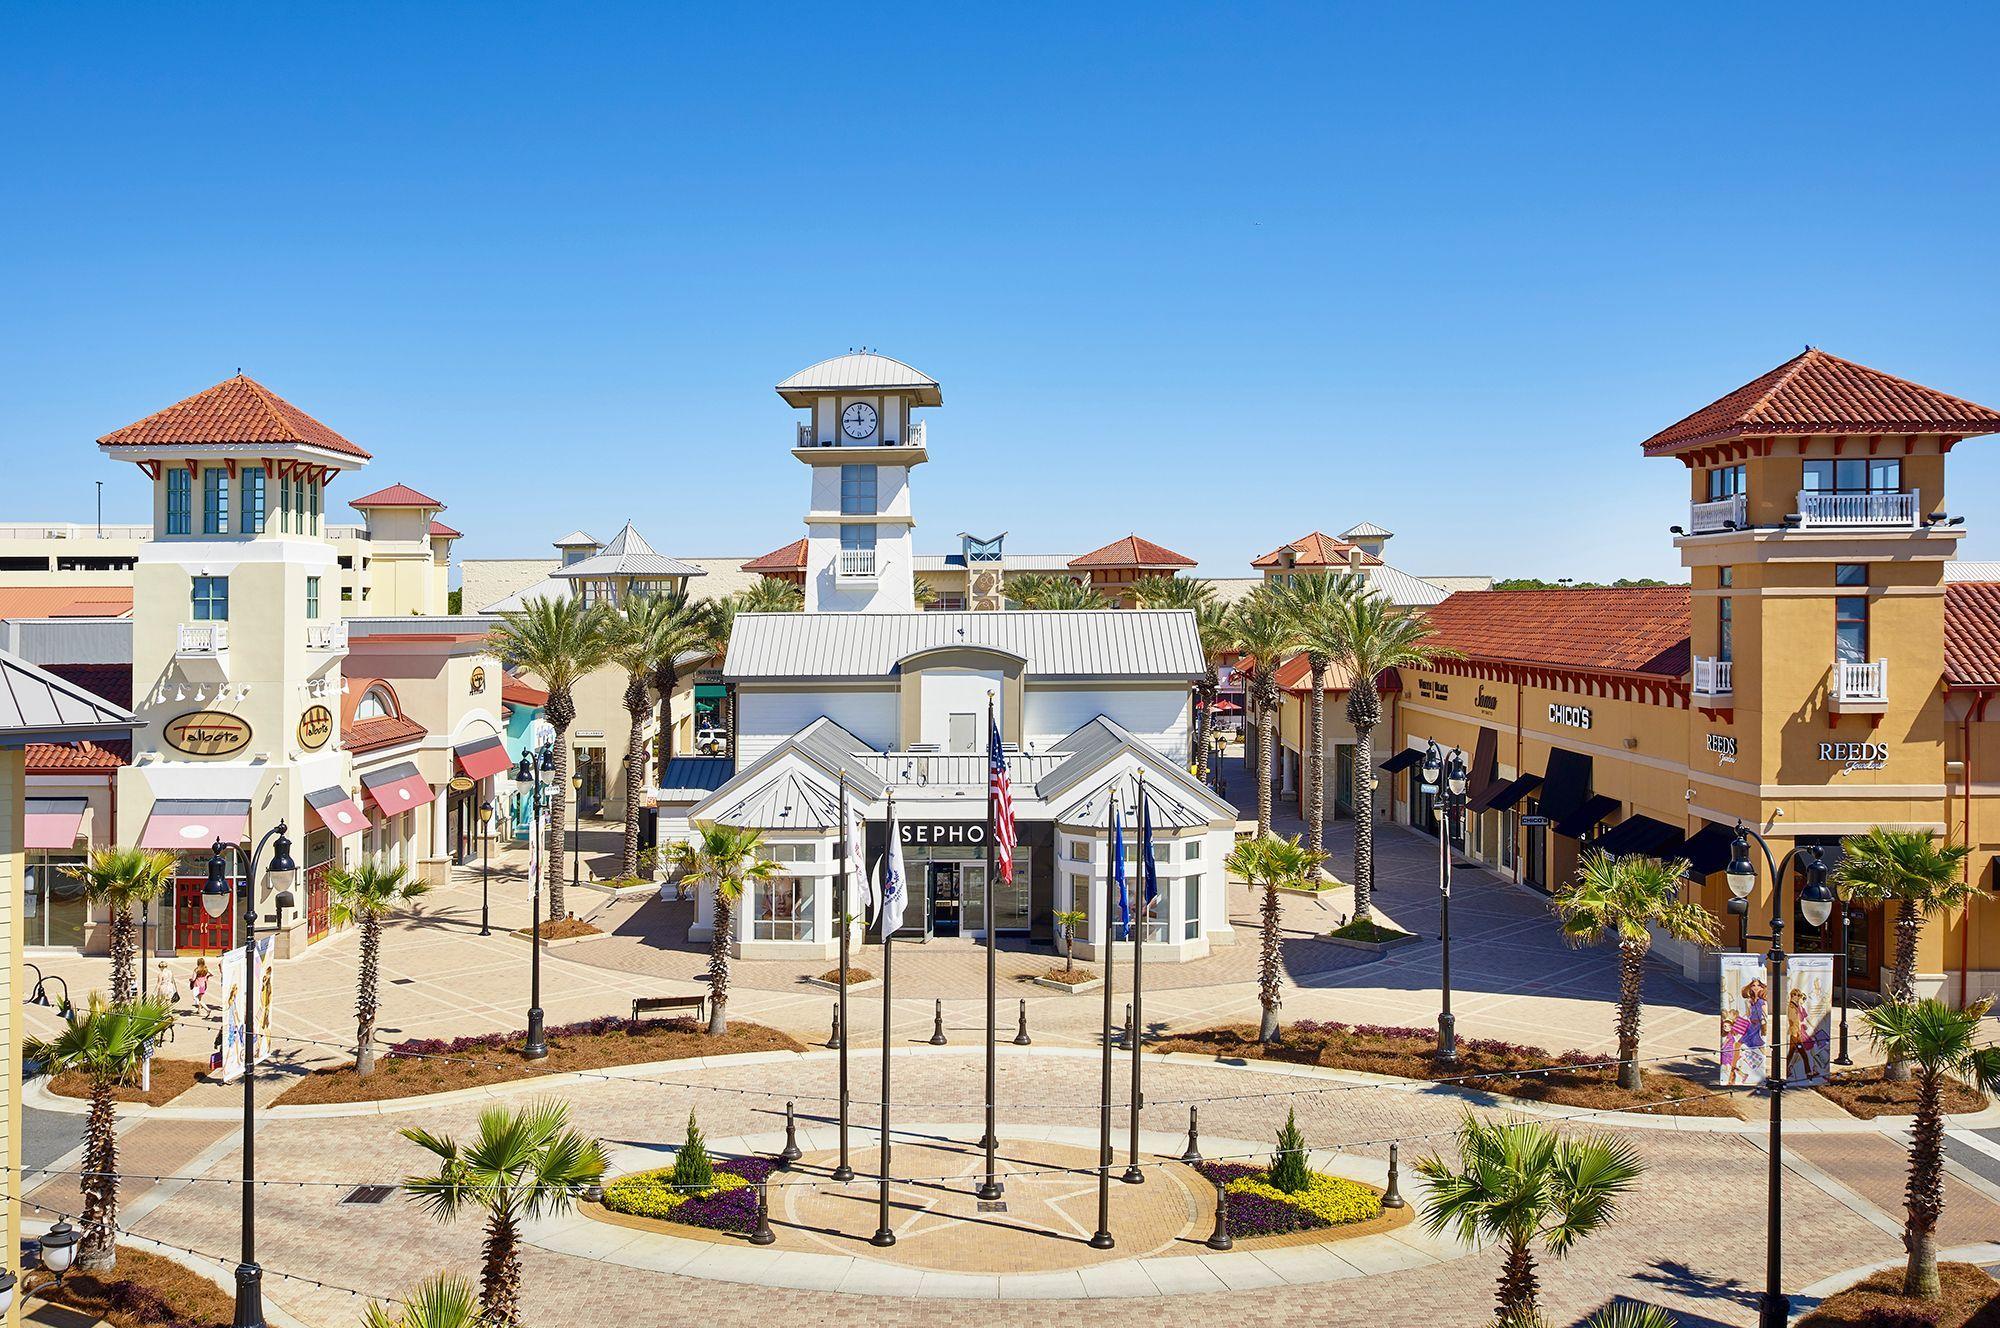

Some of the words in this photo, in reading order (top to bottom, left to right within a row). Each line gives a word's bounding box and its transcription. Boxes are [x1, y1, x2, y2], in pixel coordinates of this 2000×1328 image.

[1474, 684, 1498, 710] Soma
[1548, 703, 1592, 730] CHICO'S
[173, 725, 243, 742] Talbots
[302, 718, 329, 738] Talbots
[1706, 733, 1736, 756] REEDS
[1819, 742, 1889, 761] REEDS
[1521, 816, 1548, 825] CHICO'S
[901, 825, 1001, 843] SEPHO
